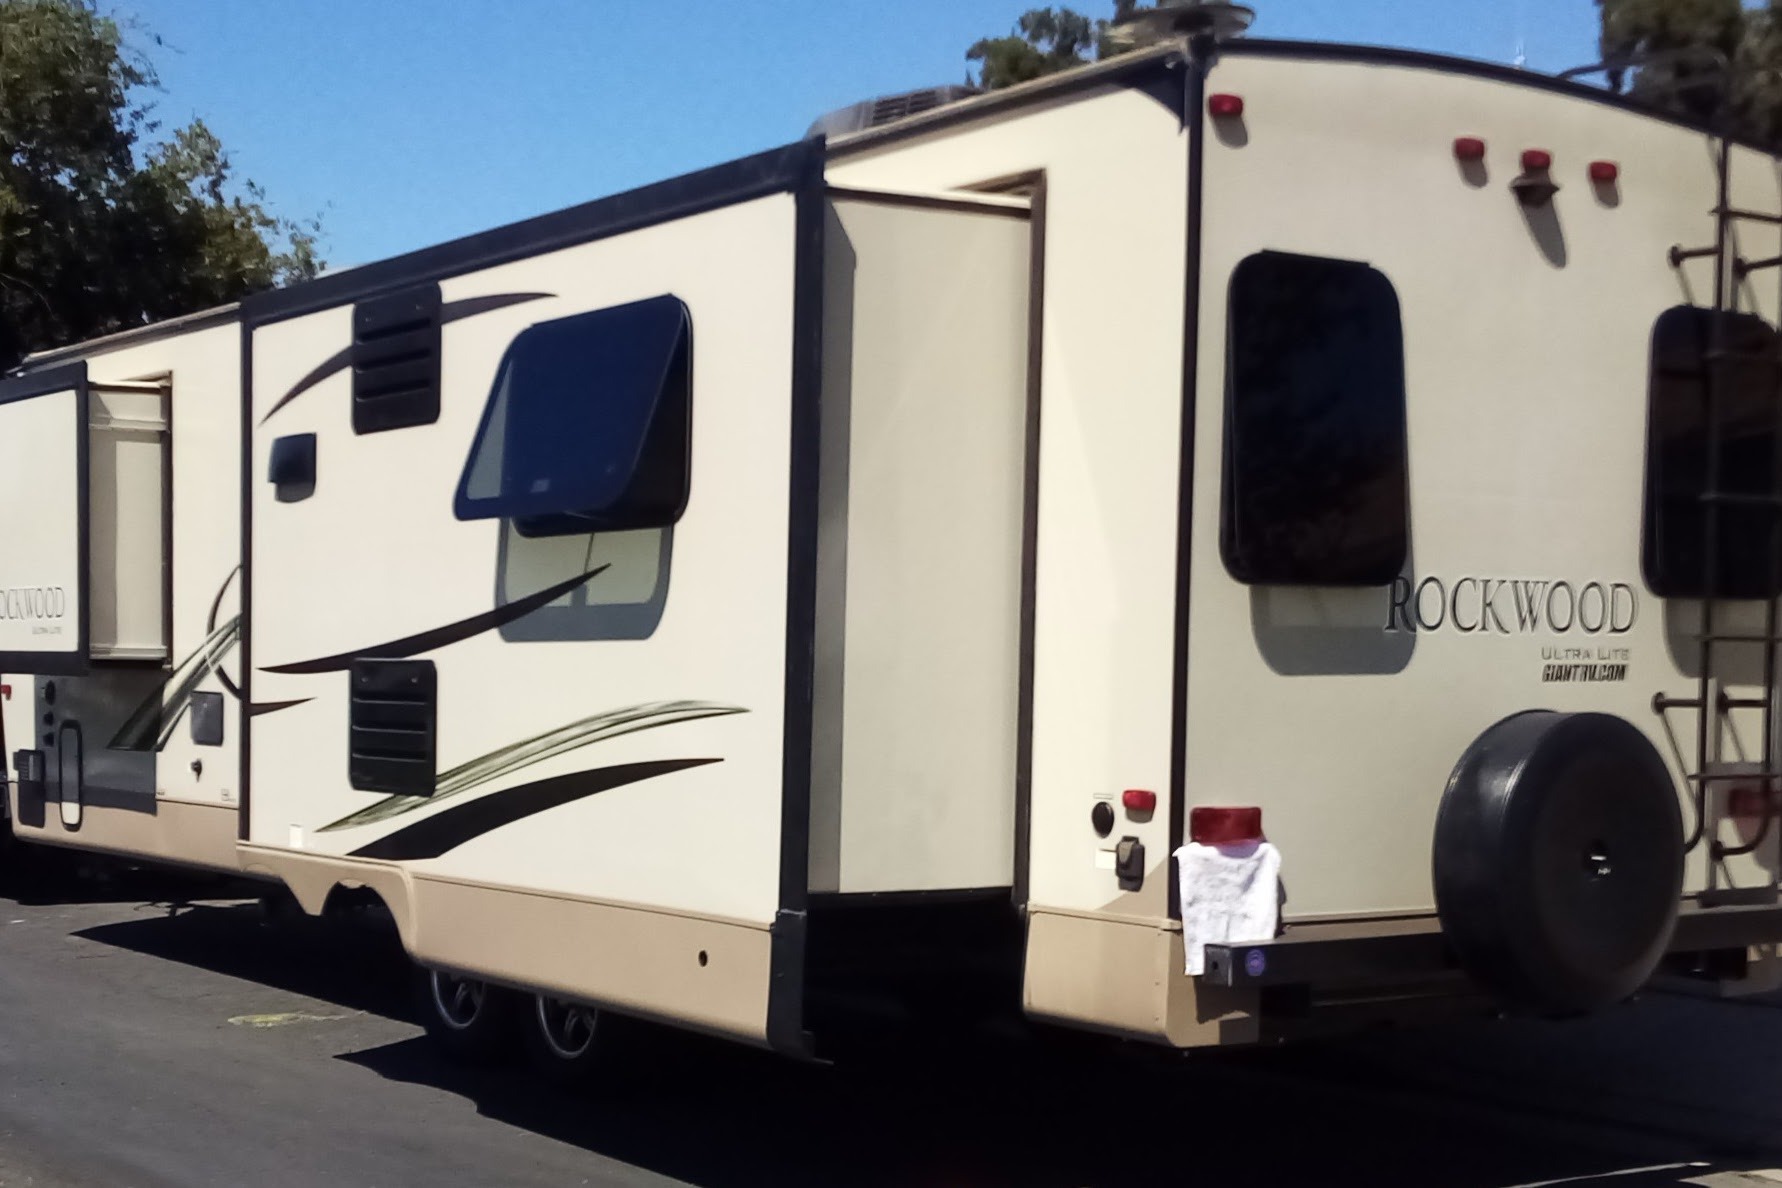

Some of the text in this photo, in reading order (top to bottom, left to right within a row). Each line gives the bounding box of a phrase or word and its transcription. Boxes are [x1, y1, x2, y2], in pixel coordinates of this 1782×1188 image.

[1384, 576, 1636, 634] ROCKWOOD
[1541, 647, 1629, 660] ULTRA LITE
